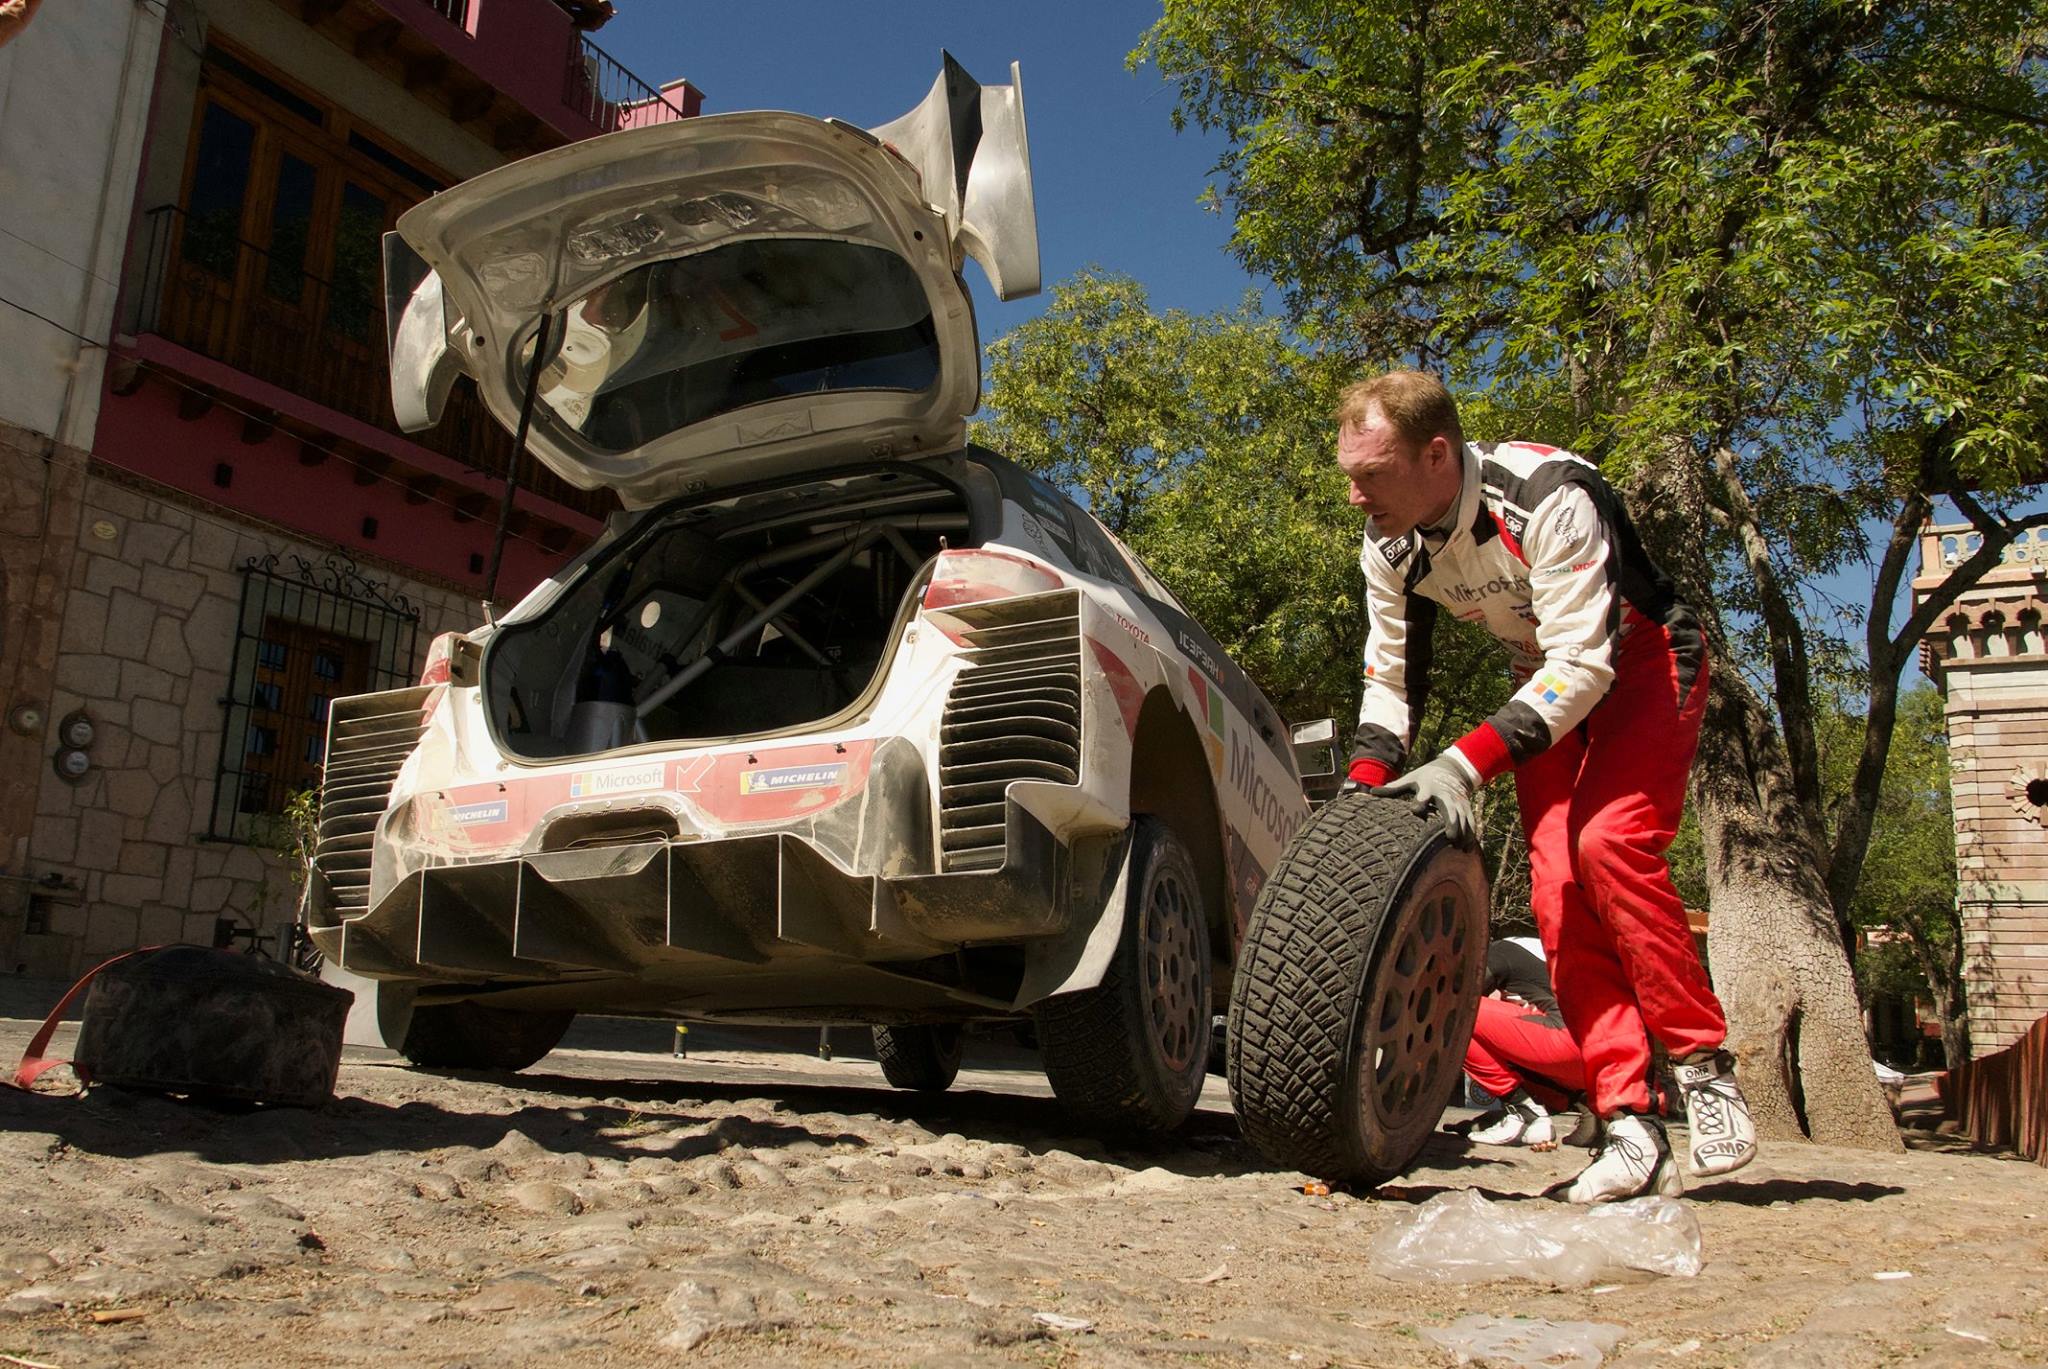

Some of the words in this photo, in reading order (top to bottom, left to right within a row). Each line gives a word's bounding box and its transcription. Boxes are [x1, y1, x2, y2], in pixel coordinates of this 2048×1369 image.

[1385, 539, 1408, 560] OMP
[1444, 575, 1528, 603] Microsft
[1116, 613, 1150, 643] TOYOTA
[596, 767, 663, 789] Microsoft
[771, 770, 838, 785] MICHELIN
[1230, 728, 1306, 849] Microso
[1685, 1066, 1710, 1079] OMP
[1701, 1143, 1745, 1155] OMP
